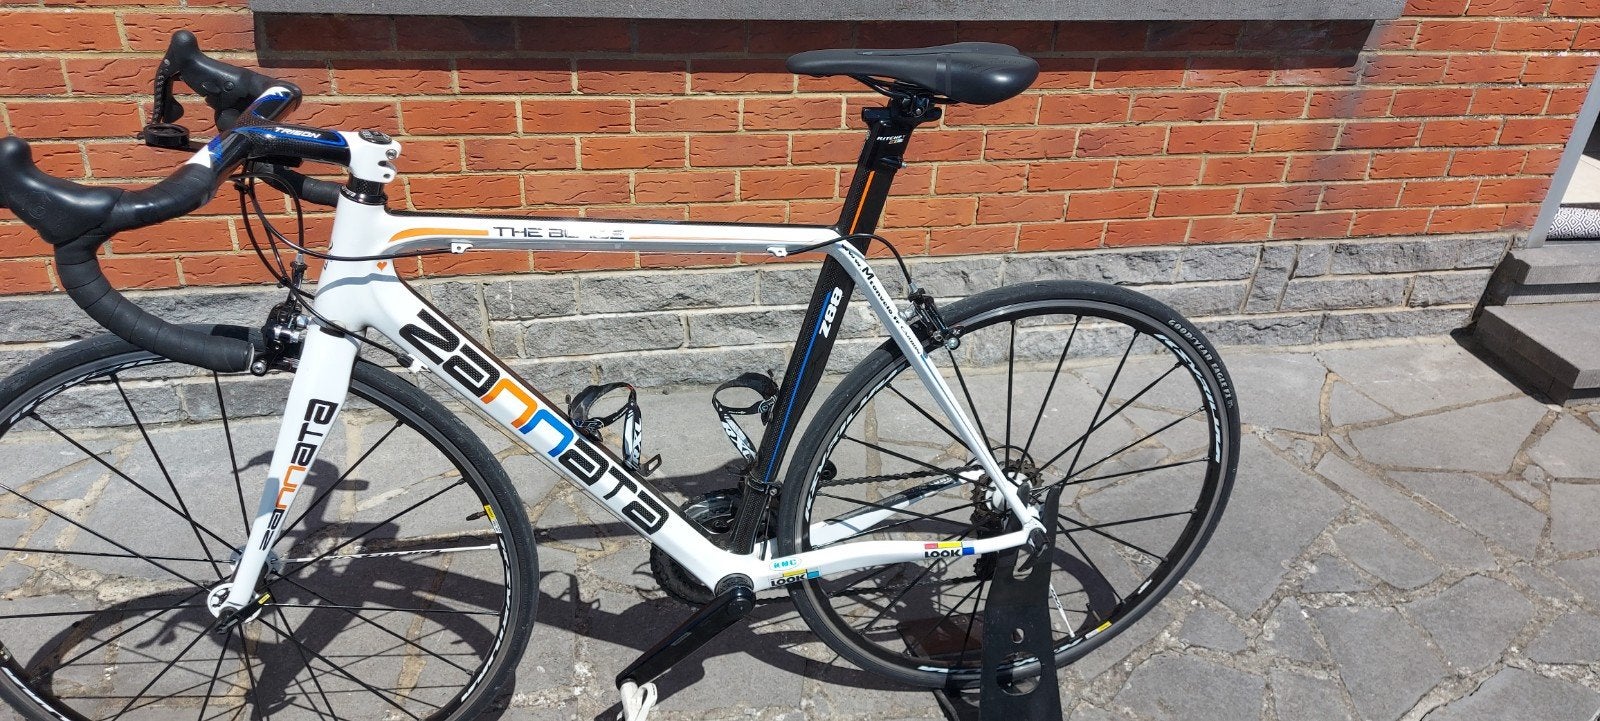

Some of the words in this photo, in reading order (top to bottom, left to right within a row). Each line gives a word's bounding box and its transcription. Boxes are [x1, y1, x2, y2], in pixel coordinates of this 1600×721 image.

[493, 226, 543, 238] THE
[819, 286, 843, 338] Z88
[1168, 319, 1213, 361] GOODYEAR
[1211, 362, 1228, 388] EAGLE
[923, 549, 961, 558] LOOK
[770, 573, 805, 587] LOOK
